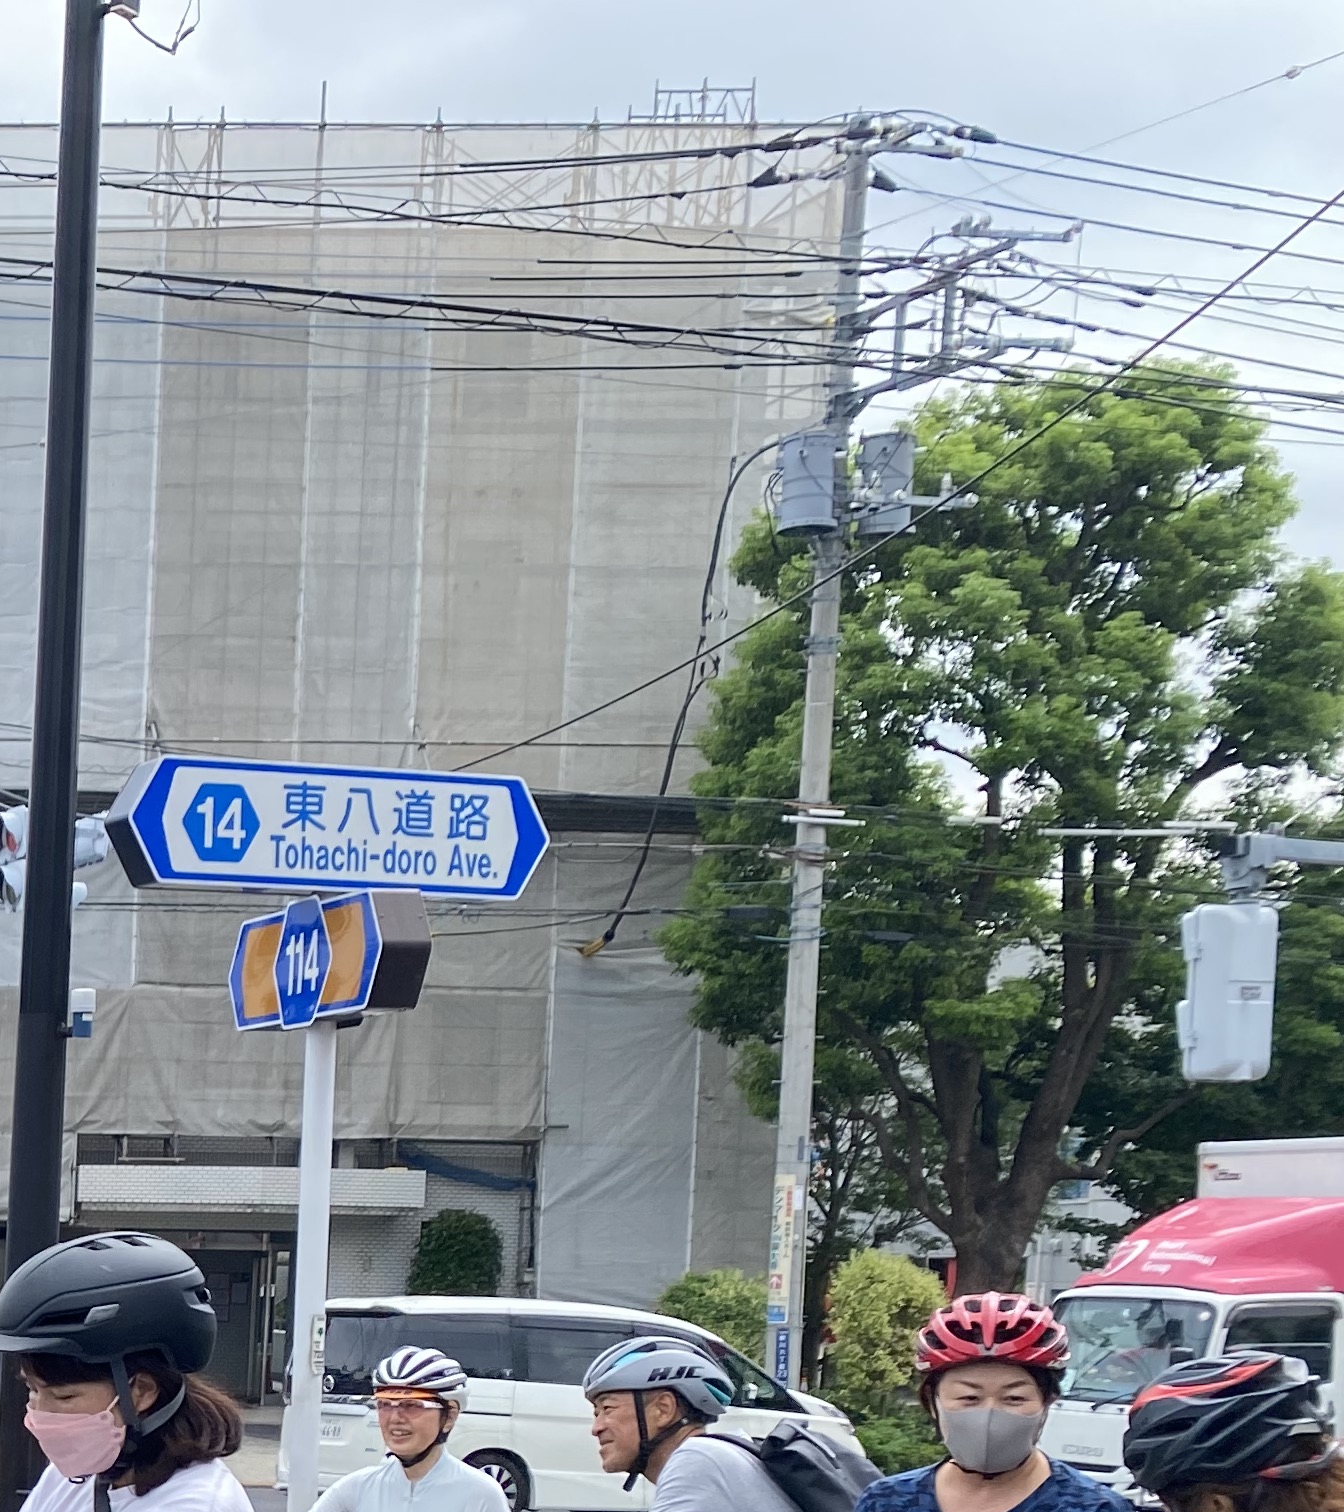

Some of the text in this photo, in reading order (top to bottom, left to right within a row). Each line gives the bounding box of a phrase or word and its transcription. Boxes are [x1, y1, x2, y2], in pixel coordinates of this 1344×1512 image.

[196, 796, 247, 851] 14
[281, 781, 492, 842] 東八道路
[270, 834, 499, 880] Tohachi-doro Ave.
[285, 928, 321, 997] 114
[646, 1365, 705, 1382] HJC
